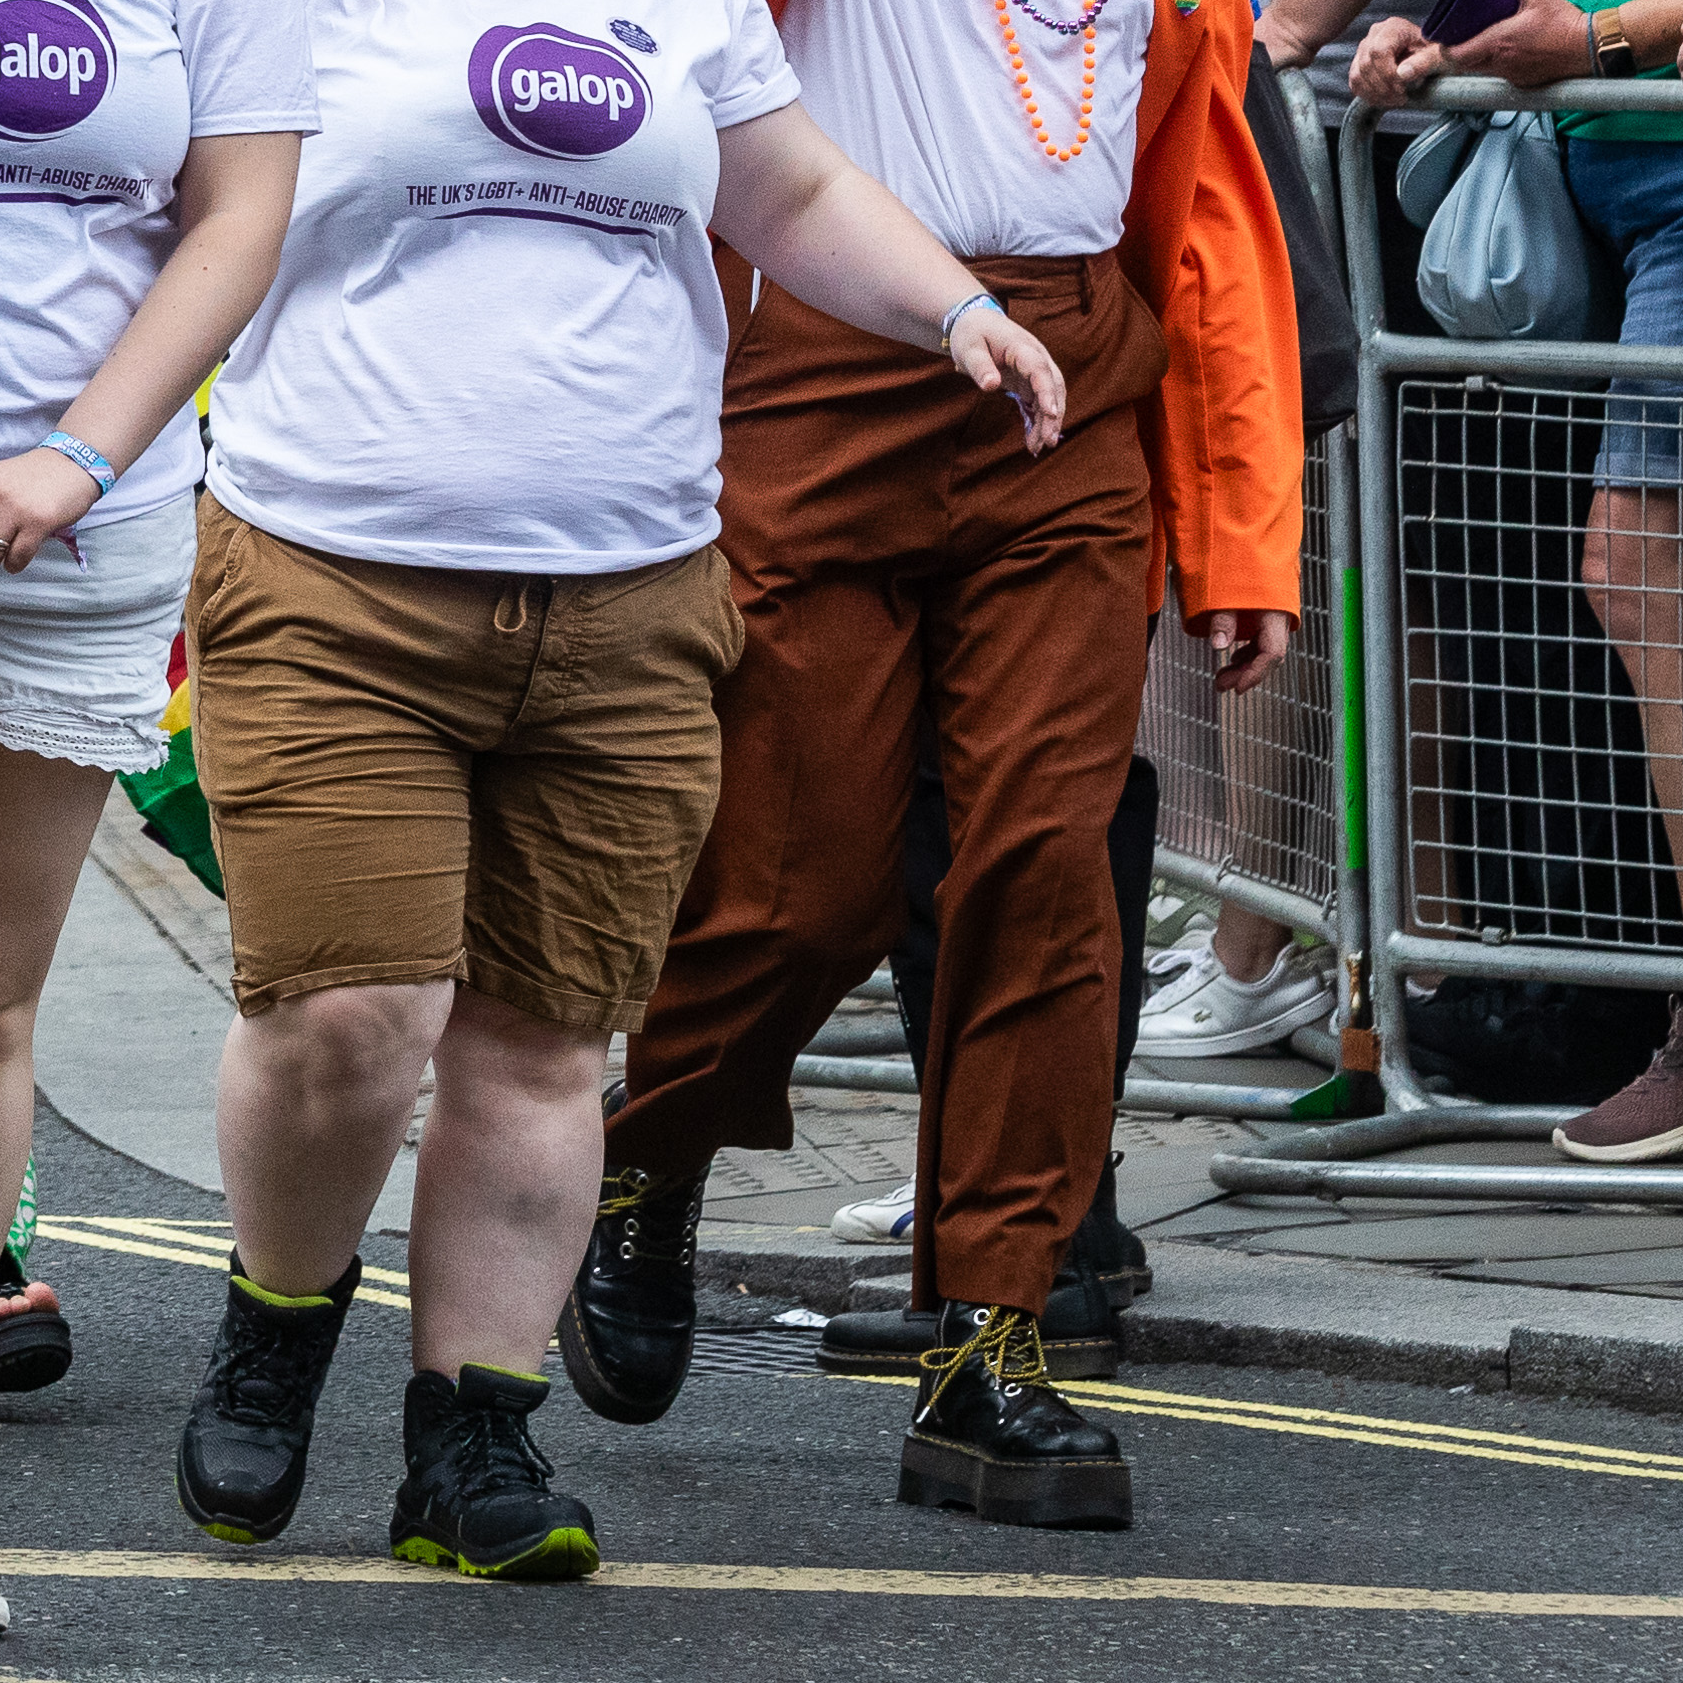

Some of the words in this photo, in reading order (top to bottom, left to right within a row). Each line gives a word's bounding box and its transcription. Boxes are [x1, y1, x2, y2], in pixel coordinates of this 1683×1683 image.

[511, 65, 634, 121] galop
[96, 174, 155, 200] CHARITY
[406, 185, 436, 206] THE
[441, 182, 476, 204] UK'S
[477, 181, 525, 200] LGBT+
[528, 182, 629, 218] ANTI-ABUSE
[630, 200, 687, 228] CHARITY
[63, 436, 98, 463] PRIDE
